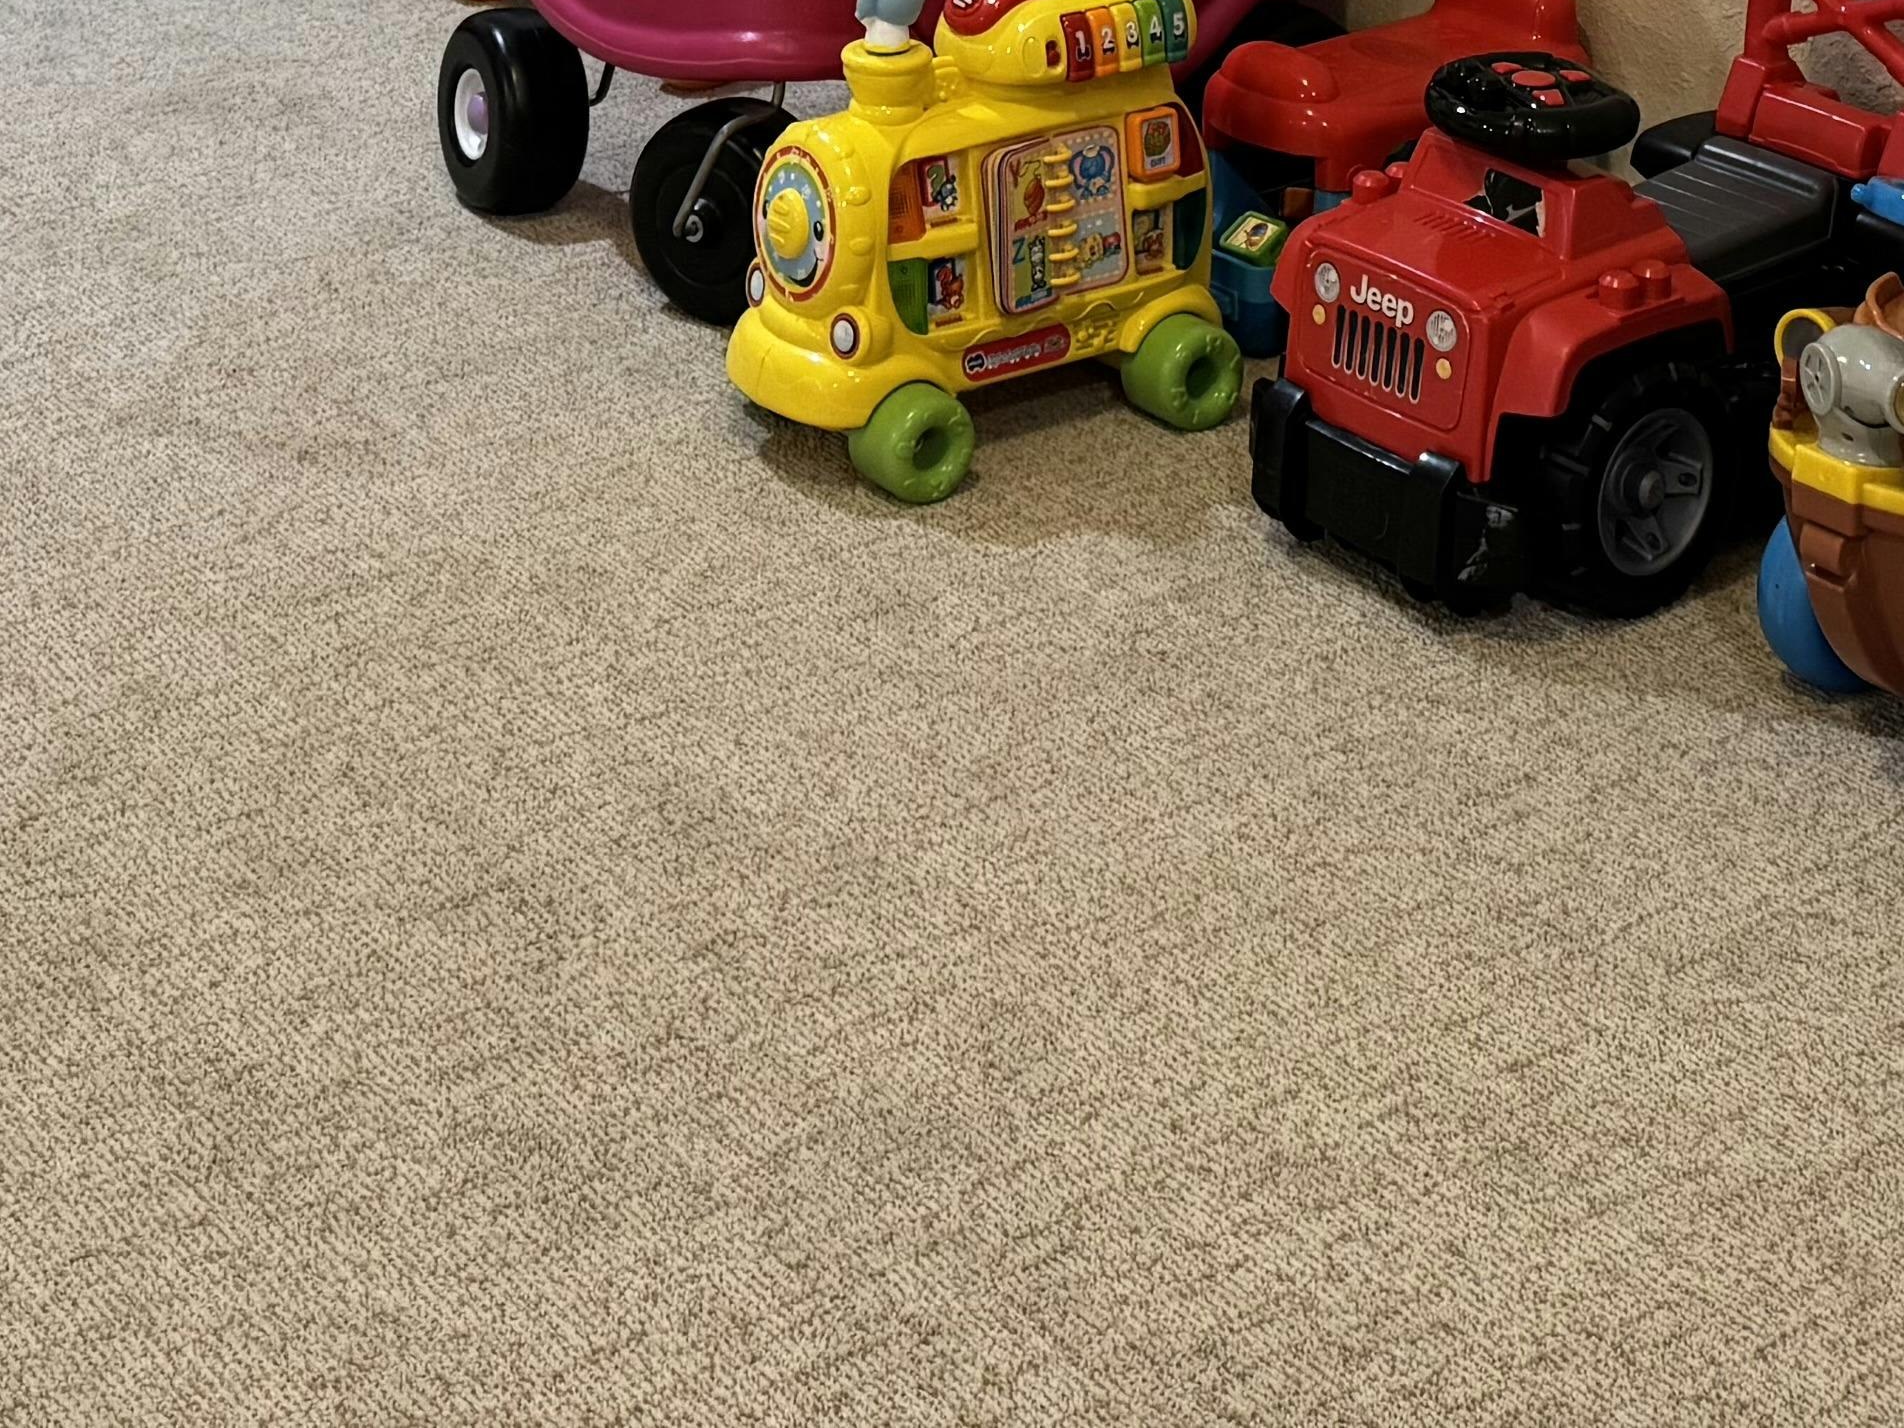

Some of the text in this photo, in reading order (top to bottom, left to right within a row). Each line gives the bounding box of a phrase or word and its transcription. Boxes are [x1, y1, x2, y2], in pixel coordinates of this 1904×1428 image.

[1075, 12, 1186, 54] 1 2 3 4 5
[1349, 273, 1415, 329] Jeep
